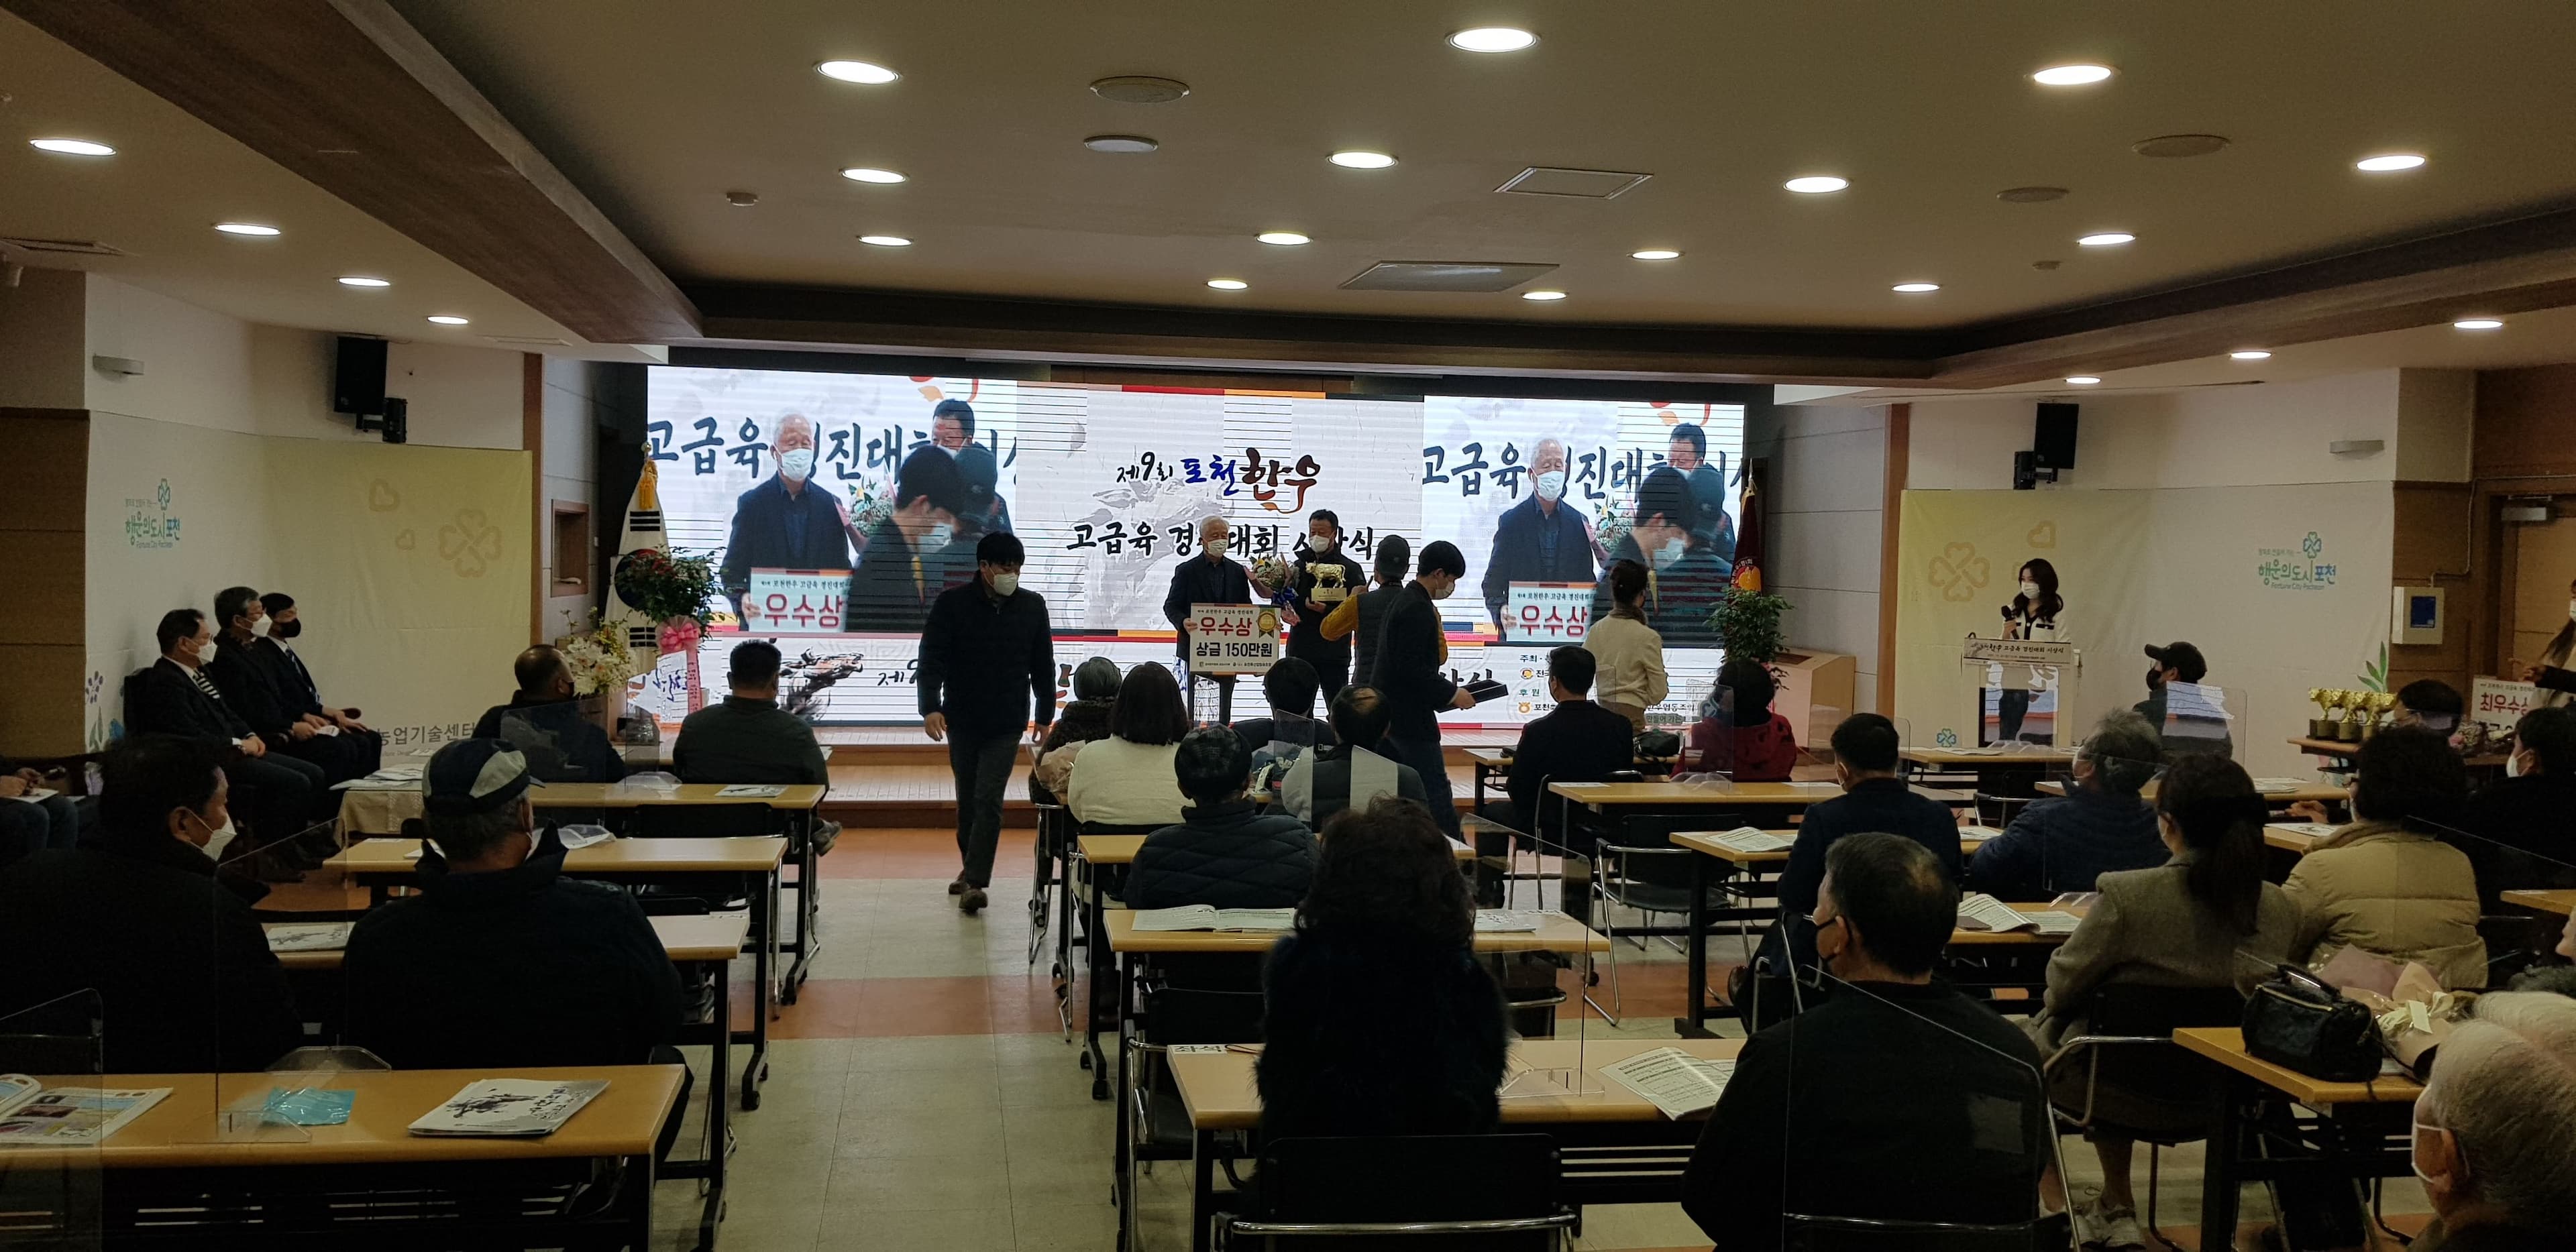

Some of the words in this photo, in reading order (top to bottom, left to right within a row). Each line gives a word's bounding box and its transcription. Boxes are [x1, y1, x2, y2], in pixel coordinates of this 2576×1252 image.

[648, 416, 769, 479] 고급육
[808, 421, 931, 484] 진대
[1116, 451, 1173, 482] 제9회
[1181, 454, 1239, 496] 포천
[1239, 447, 1321, 514] 한우
[1422, 442, 1526, 499] 고급육
[1560, 445, 1668, 503] 진대
[1066, 521, 1158, 556] 고급육
[1169, 522, 1278, 559] 경대회
[764, 593, 843, 629] 우수상
[1199, 616, 1253, 637] 우수상
[1519, 605, 1588, 638] 우수상
[1196, 642, 1221, 657] 상금
[1225, 642, 1273, 658] 150만원
[377, 722, 475, 746] 농업기술센터
